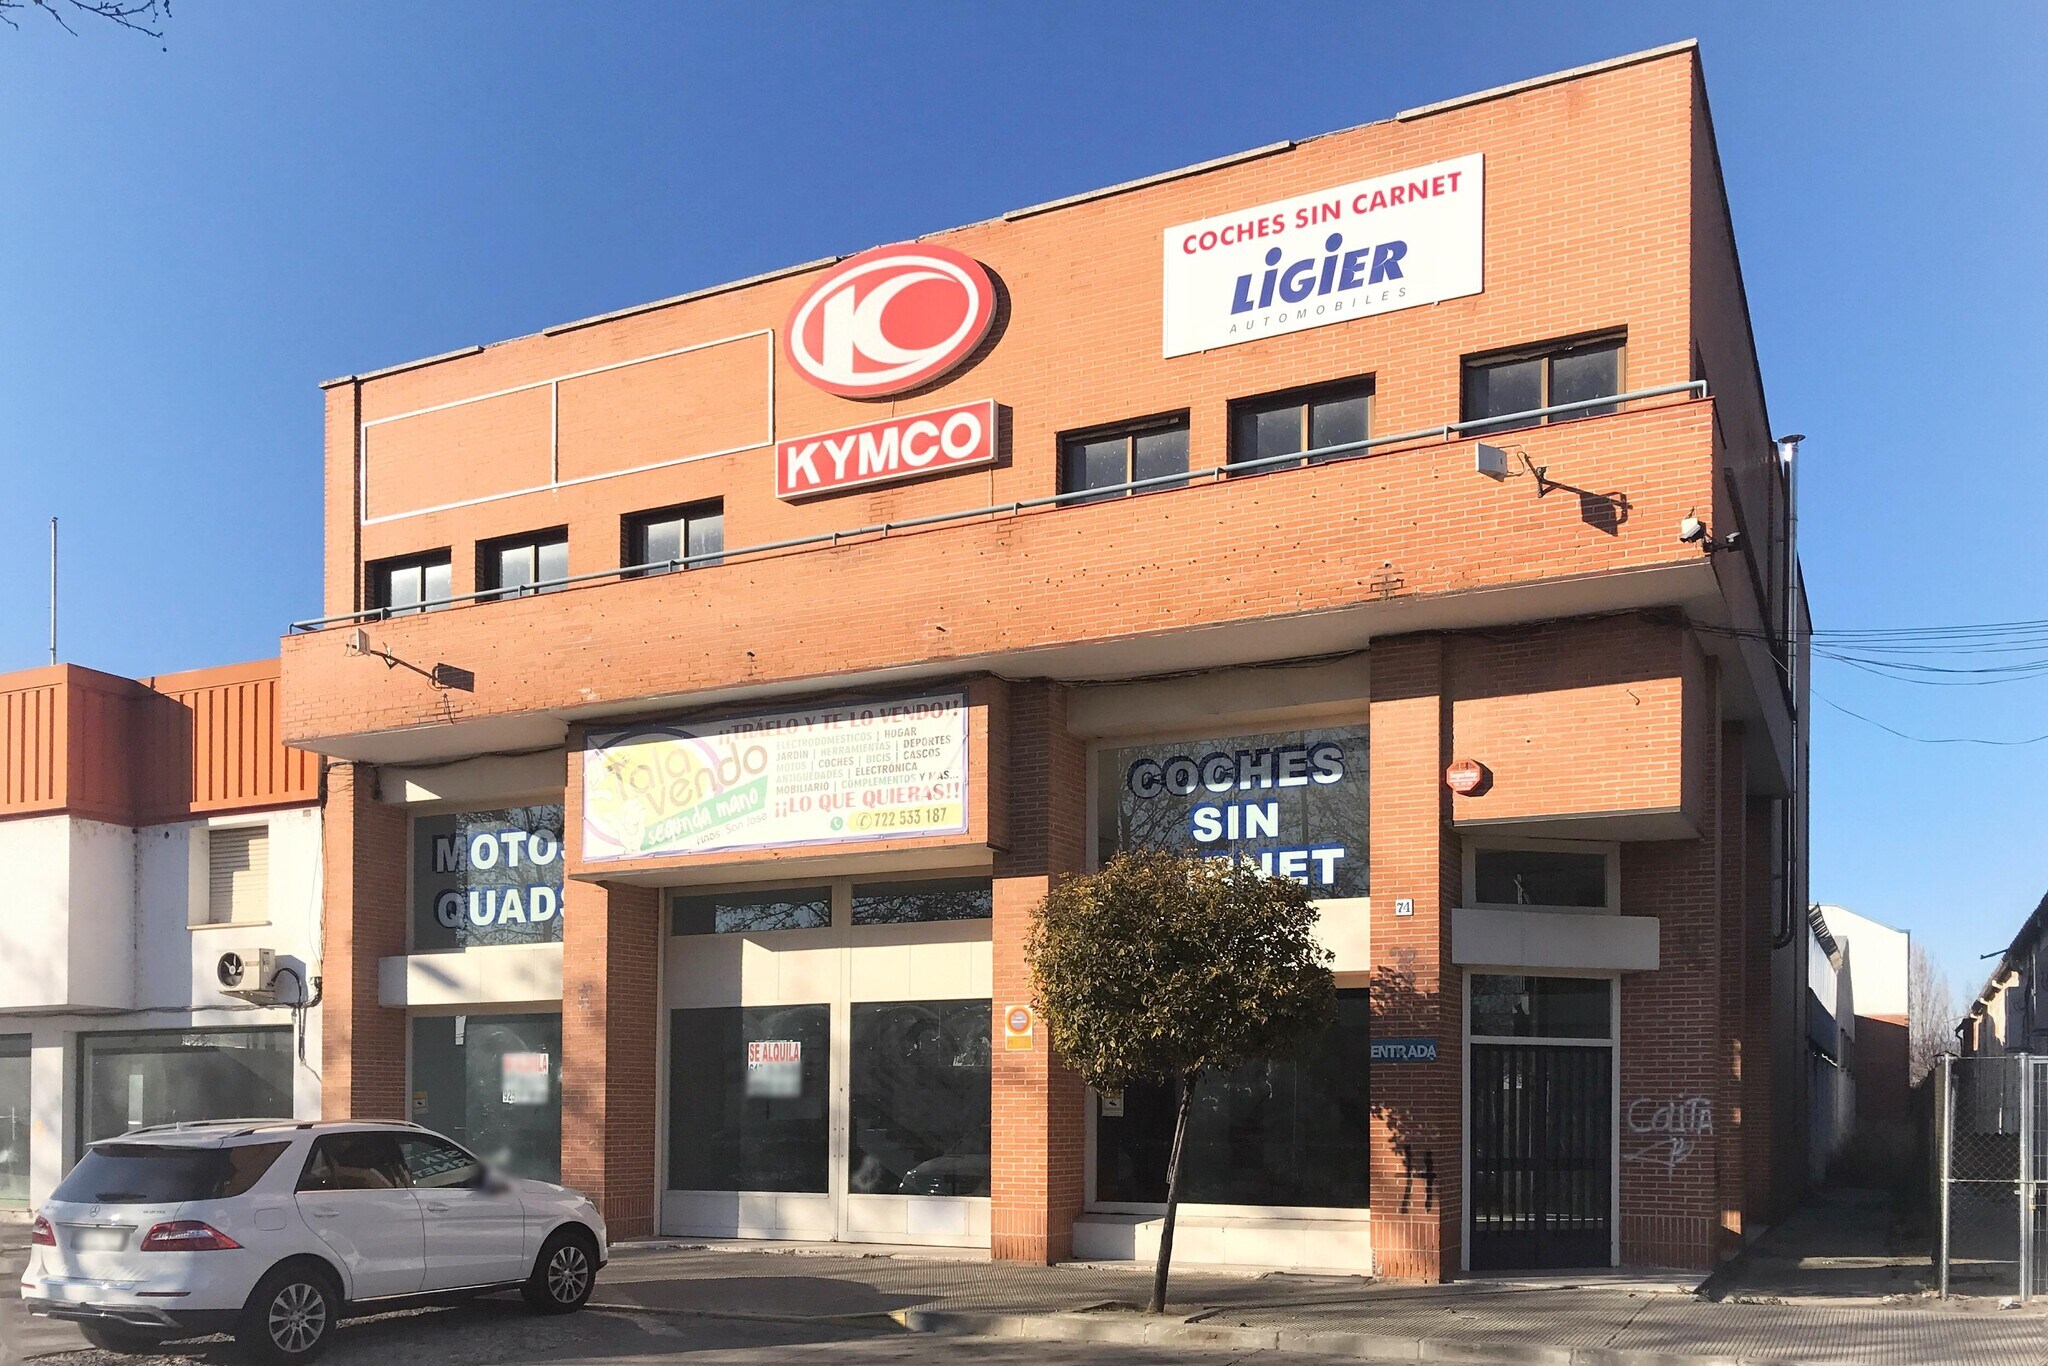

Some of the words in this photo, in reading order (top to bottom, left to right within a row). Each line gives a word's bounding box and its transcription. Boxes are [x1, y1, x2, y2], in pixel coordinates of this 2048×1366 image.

[1183, 213, 1285, 254] COCHES
[1295, 200, 1341, 229] SIN
[1352, 171, 1462, 215] CARNET
[1229, 287, 1407, 334] AUTOMOBILES
[787, 412, 982, 489] KYMCO
[804, 716, 816, 732] Y
[821, 712, 844, 730] TE
[850, 709, 874, 727] LO
[879, 700, 959, 724] VENDO!!
[820, 742, 891, 756] HERRAMIENTAS
[903, 735, 952, 748] DEPORTES
[884, 727, 917, 739] HOGAR
[776, 762, 807, 773] MOTOS
[818, 757, 855, 769] COCHES
[866, 754, 891, 764] BICIS
[903, 748, 941, 760] CASCOS
[855, 761, 918, 777] ELECTRÓNICA
[1129, 744, 1345, 799] COCHES
[647, 742, 768, 816] vendo
[776, 782, 829, 795] MOBILIARIO
[841, 774, 916, 789] COMPLEMENTOS
[919, 773, 926, 782] Y
[818, 791, 857, 813] QUE
[862, 782, 960, 808] QUIERAS!!
[648, 805, 713, 846] segunda
[716, 787, 758, 819] mano
[874, 812, 896, 827] 722
[899, 809, 921, 825] 533
[926, 807, 947, 823] 187
[1191, 799, 1280, 843] SIN
[433, 828, 565, 873] MOTO
[435, 885, 565, 930] QUAD
[1396, 902, 1411, 913] 74
[750, 1043, 760, 1062] SE
[763, 1042, 799, 1062] ALQUILA
[1370, 1044, 1437, 1060] ENTRADA
